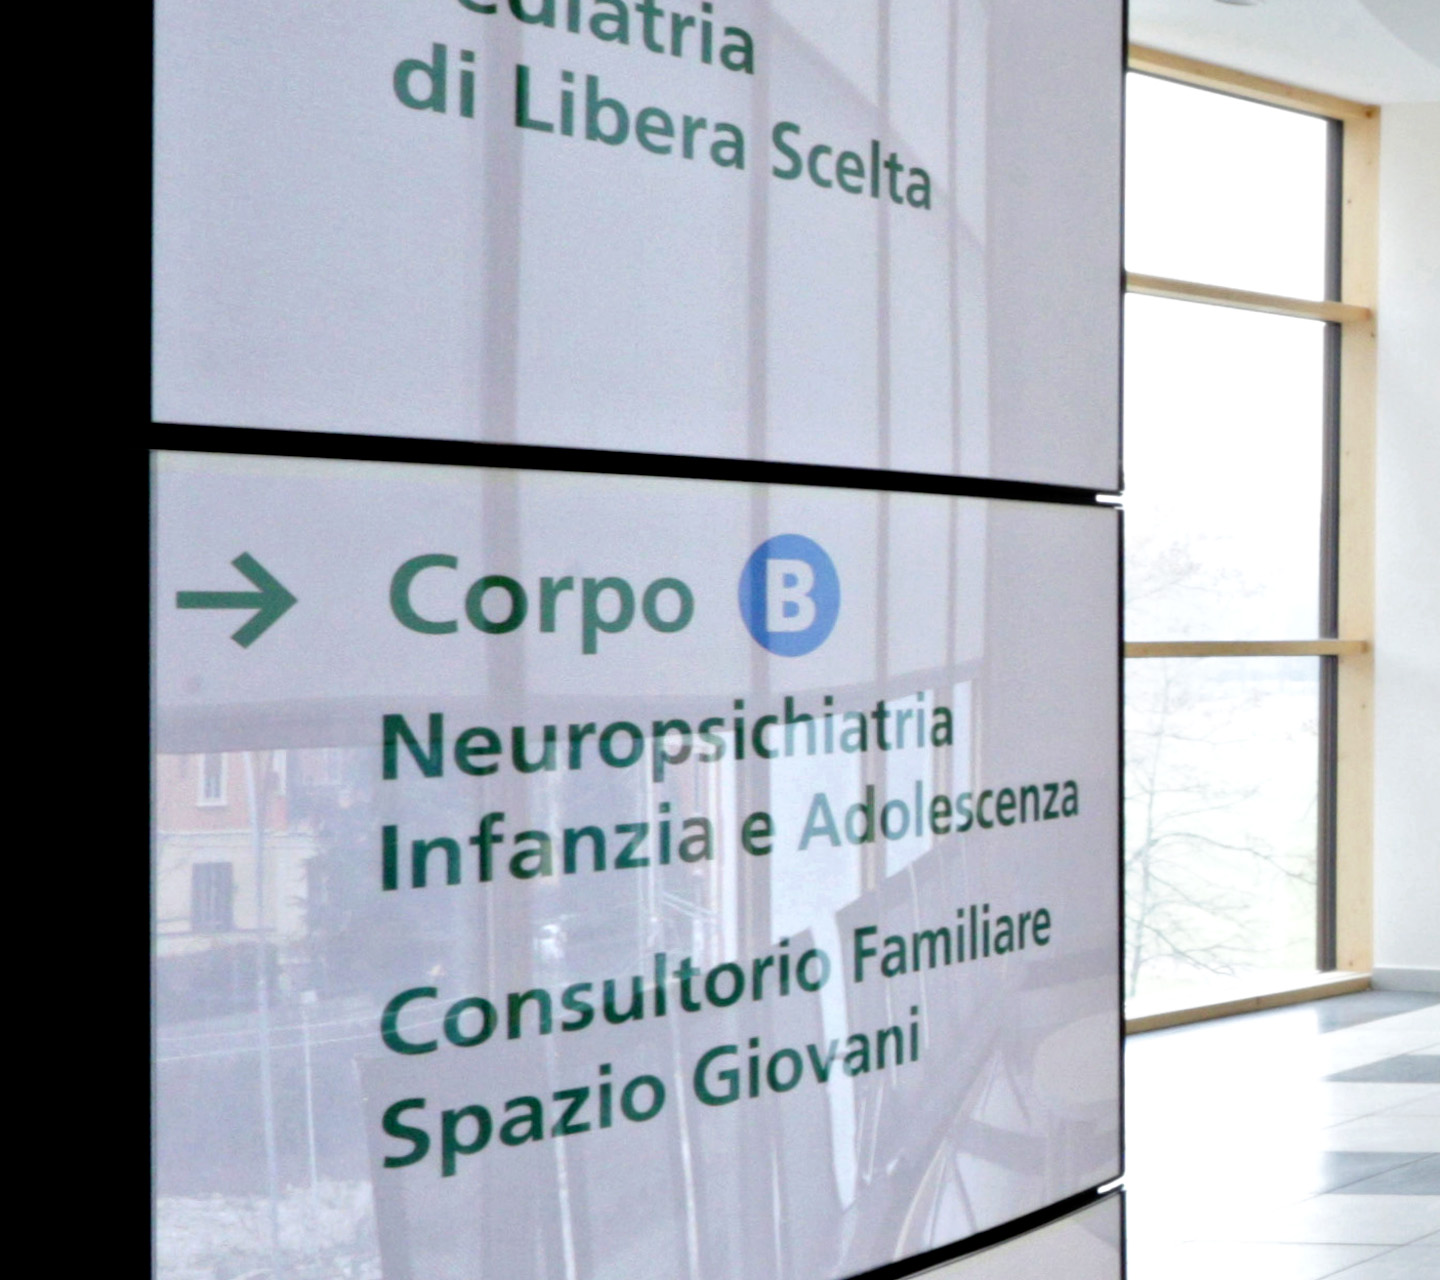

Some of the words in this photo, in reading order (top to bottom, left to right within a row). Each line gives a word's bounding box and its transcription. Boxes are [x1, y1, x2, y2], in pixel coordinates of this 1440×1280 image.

[393, 43, 475, 118] di
[514, 63, 746, 171] Libera
[770, 123, 932, 211] Scelta
[388, 551, 696, 654] Corpo
[766, 558, 817, 632] B
[381, 691, 954, 782] Neuropsichiatria
[381, 801, 714, 893] Infanzia
[741, 813, 775, 858] e
[797, 777, 1080, 854] Adolescenza
[381, 939, 831, 1057] Consultorio
[851, 904, 1053, 983] Familiare
[381, 1064, 667, 1179] Spazio
[692, 1006, 921, 1109] Giovani
